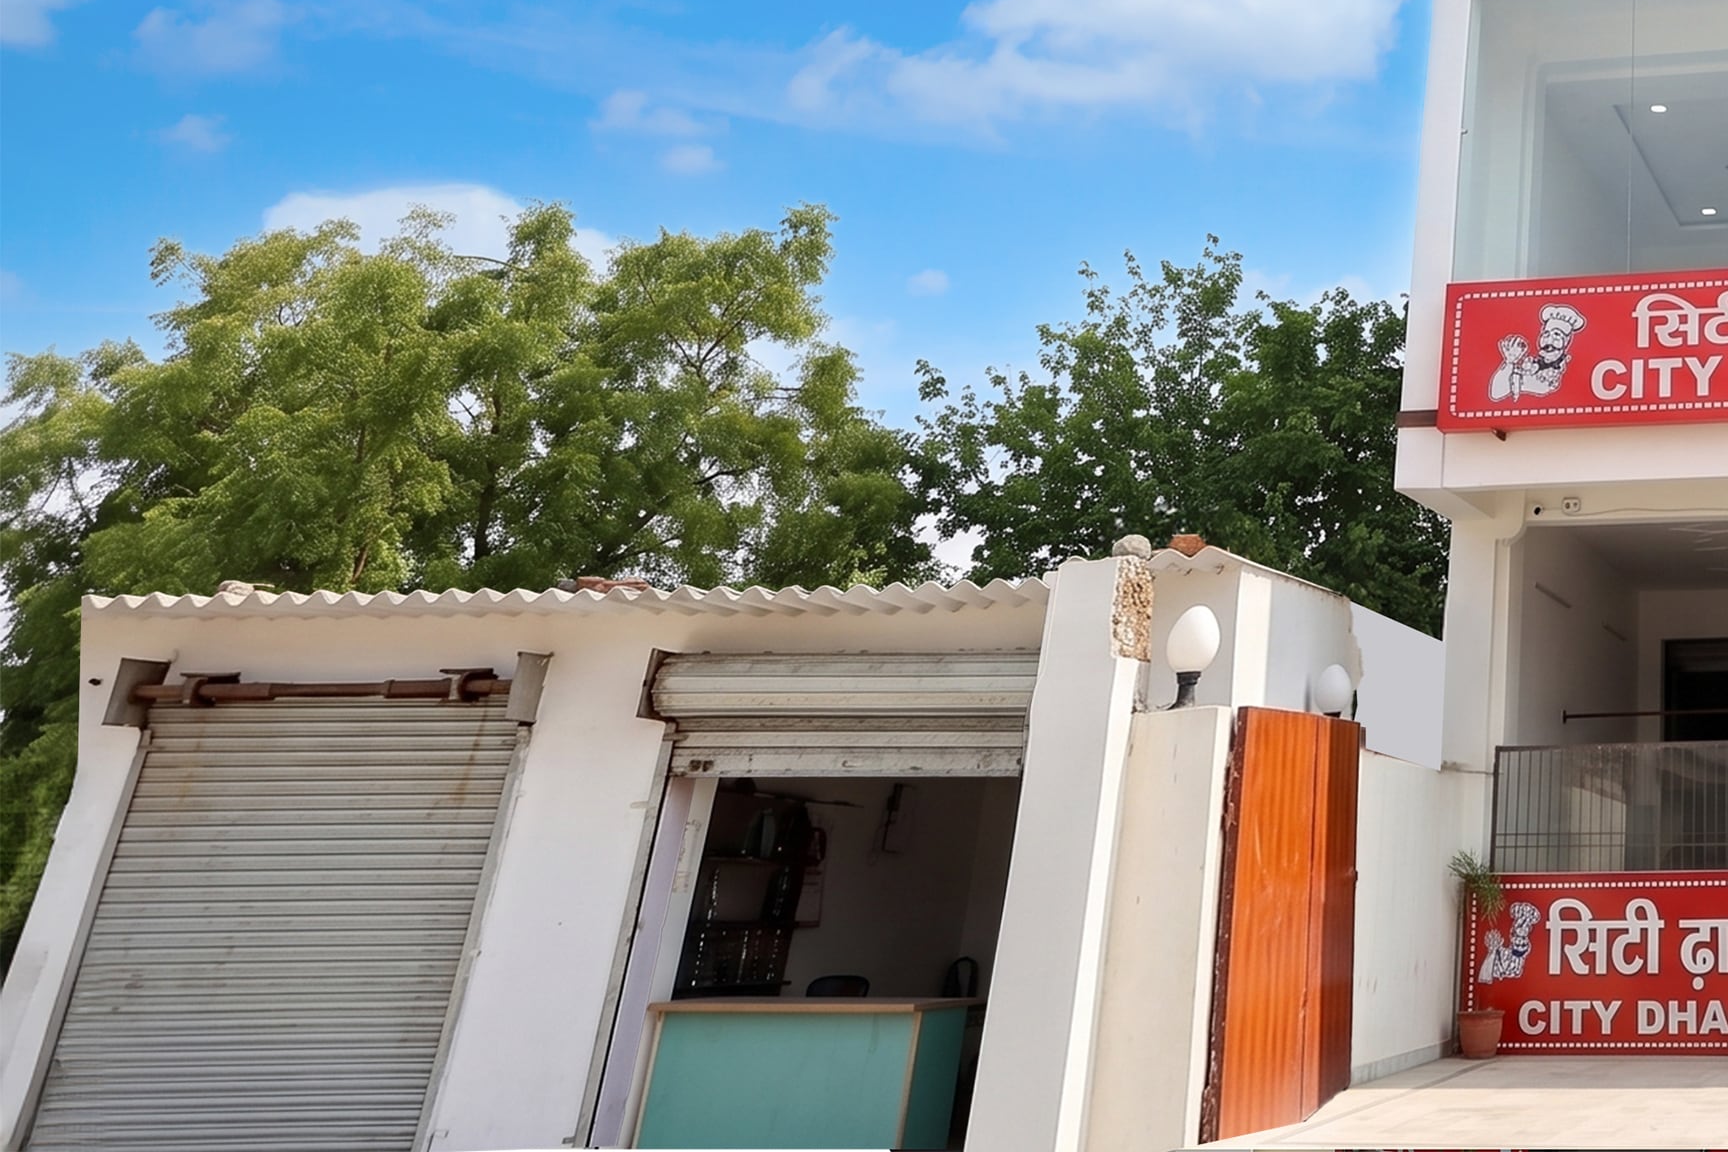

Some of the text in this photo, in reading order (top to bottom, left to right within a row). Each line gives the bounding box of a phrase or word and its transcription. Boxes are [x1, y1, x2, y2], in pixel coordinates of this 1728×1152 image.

[1590, 353, 1725, 401] CITY
[1546, 898, 1665, 975] सिटी
[1518, 1000, 1622, 1035] CITY
